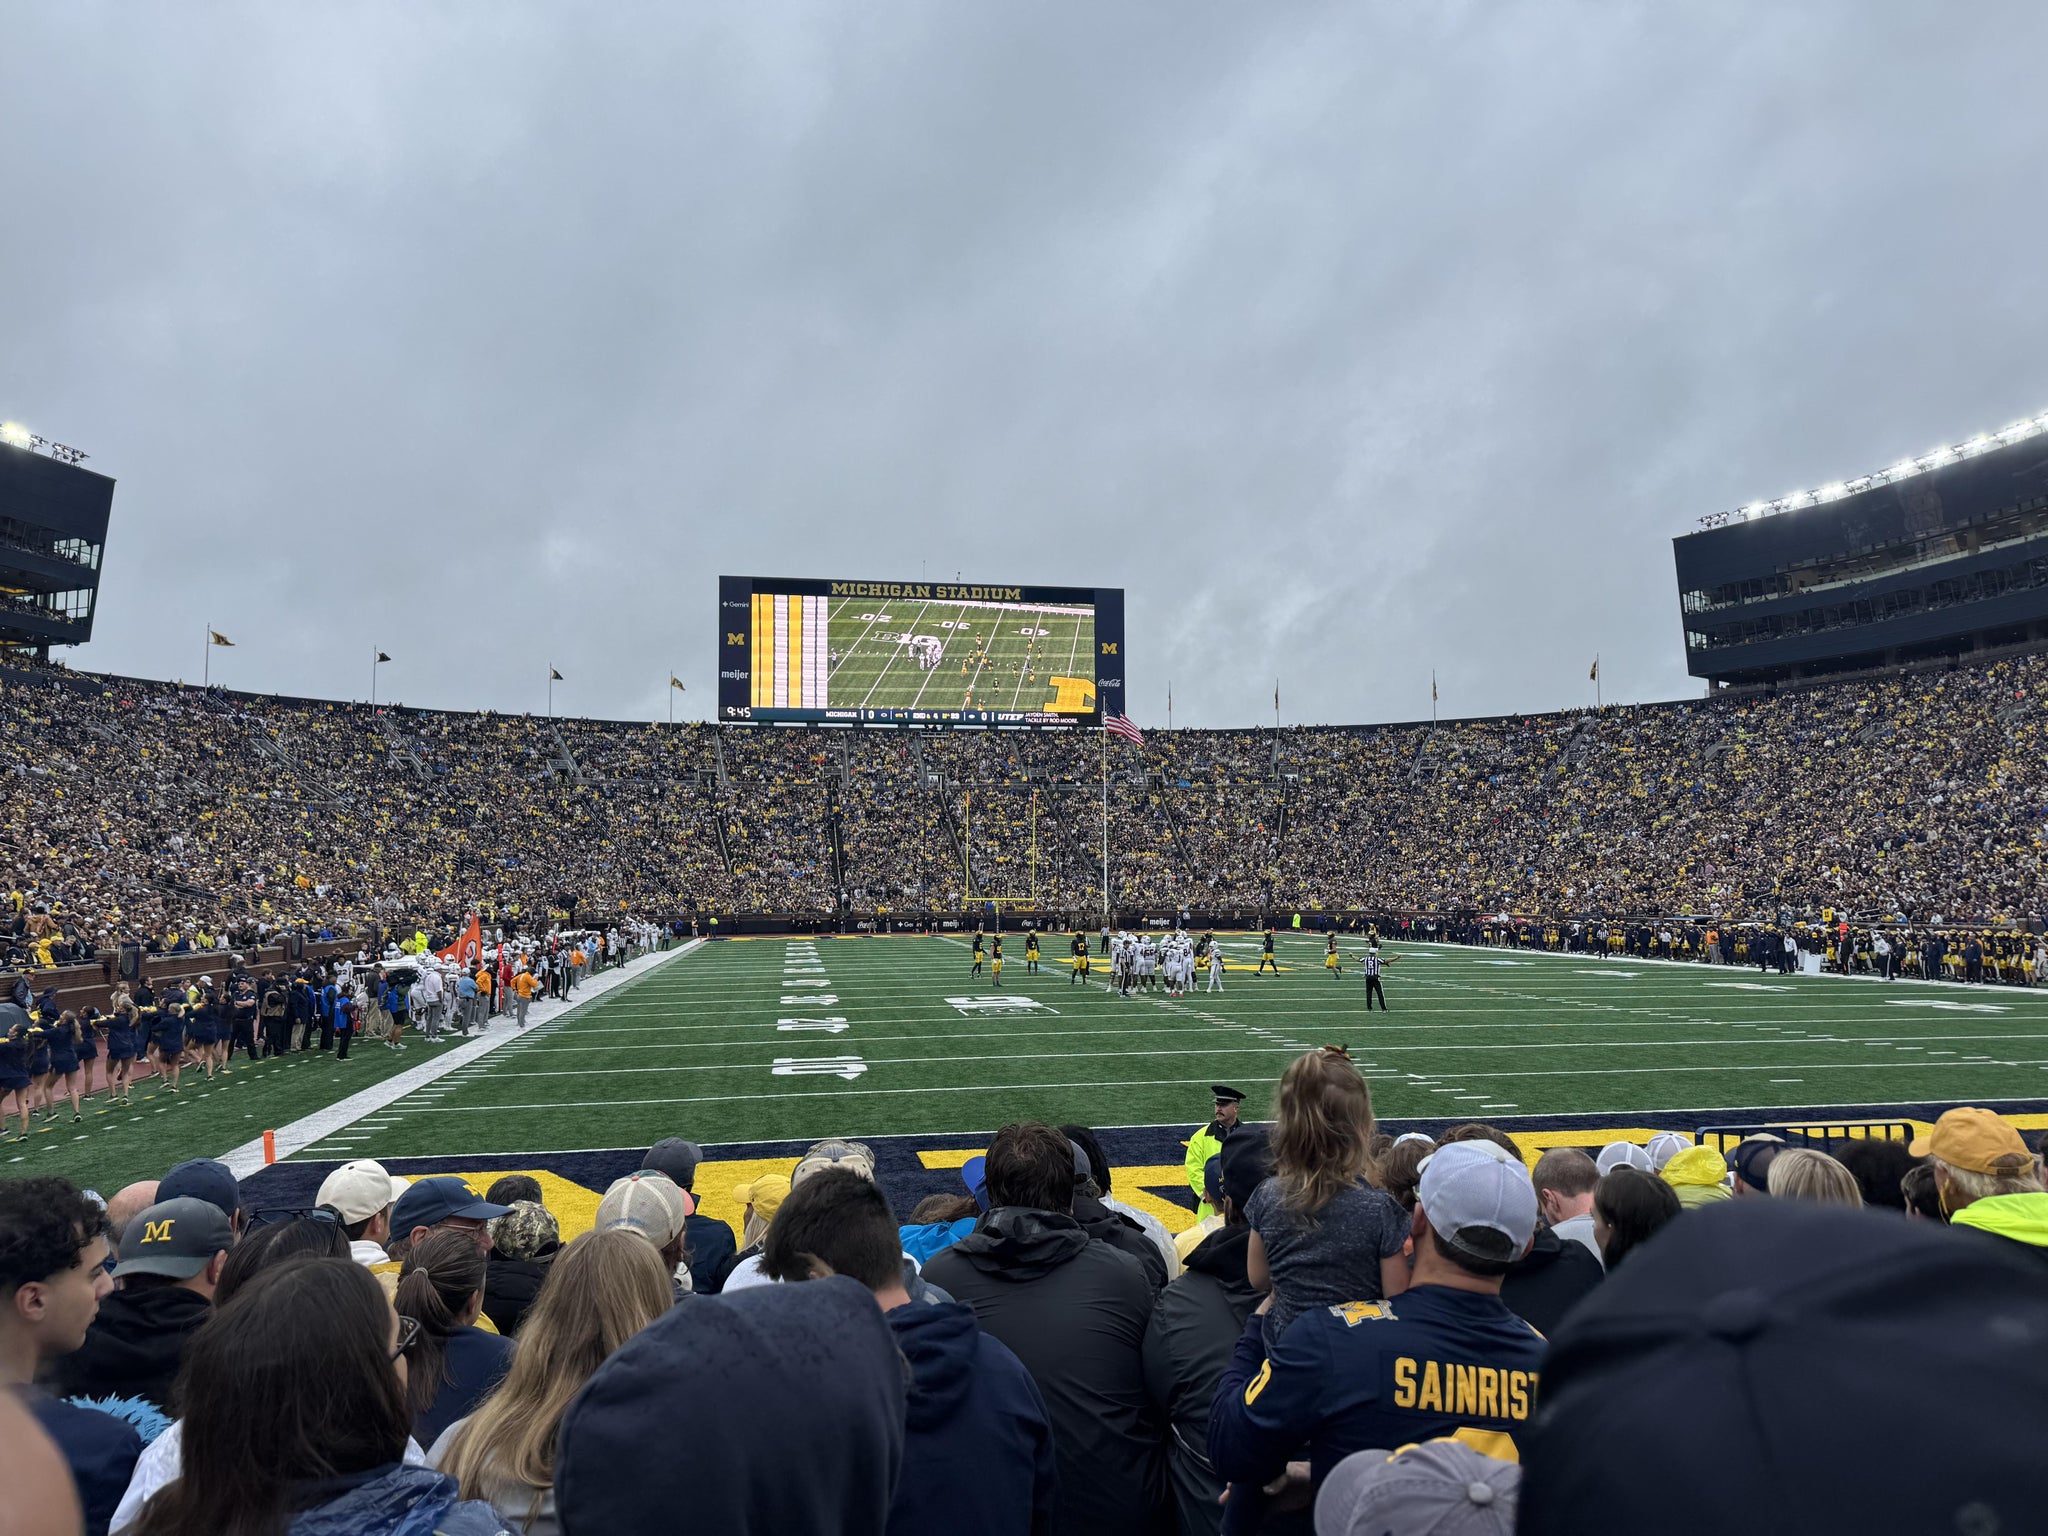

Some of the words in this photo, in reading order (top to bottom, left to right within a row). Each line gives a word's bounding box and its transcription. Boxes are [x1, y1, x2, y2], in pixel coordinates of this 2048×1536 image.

[831, 582, 931, 598] MICHIGAN
[936, 586, 1021, 600] STADIUM
[727, 633, 745, 645] M
[1101, 642, 1118, 655] M
[721, 670, 749, 680] meijer
[726, 706, 751, 718] 9:45
[868, 710, 875, 719] 0
[1149, 917, 1170, 926] meijer
[1367, 960, 1375, 969] R
[140, 1219, 176, 1244] M
